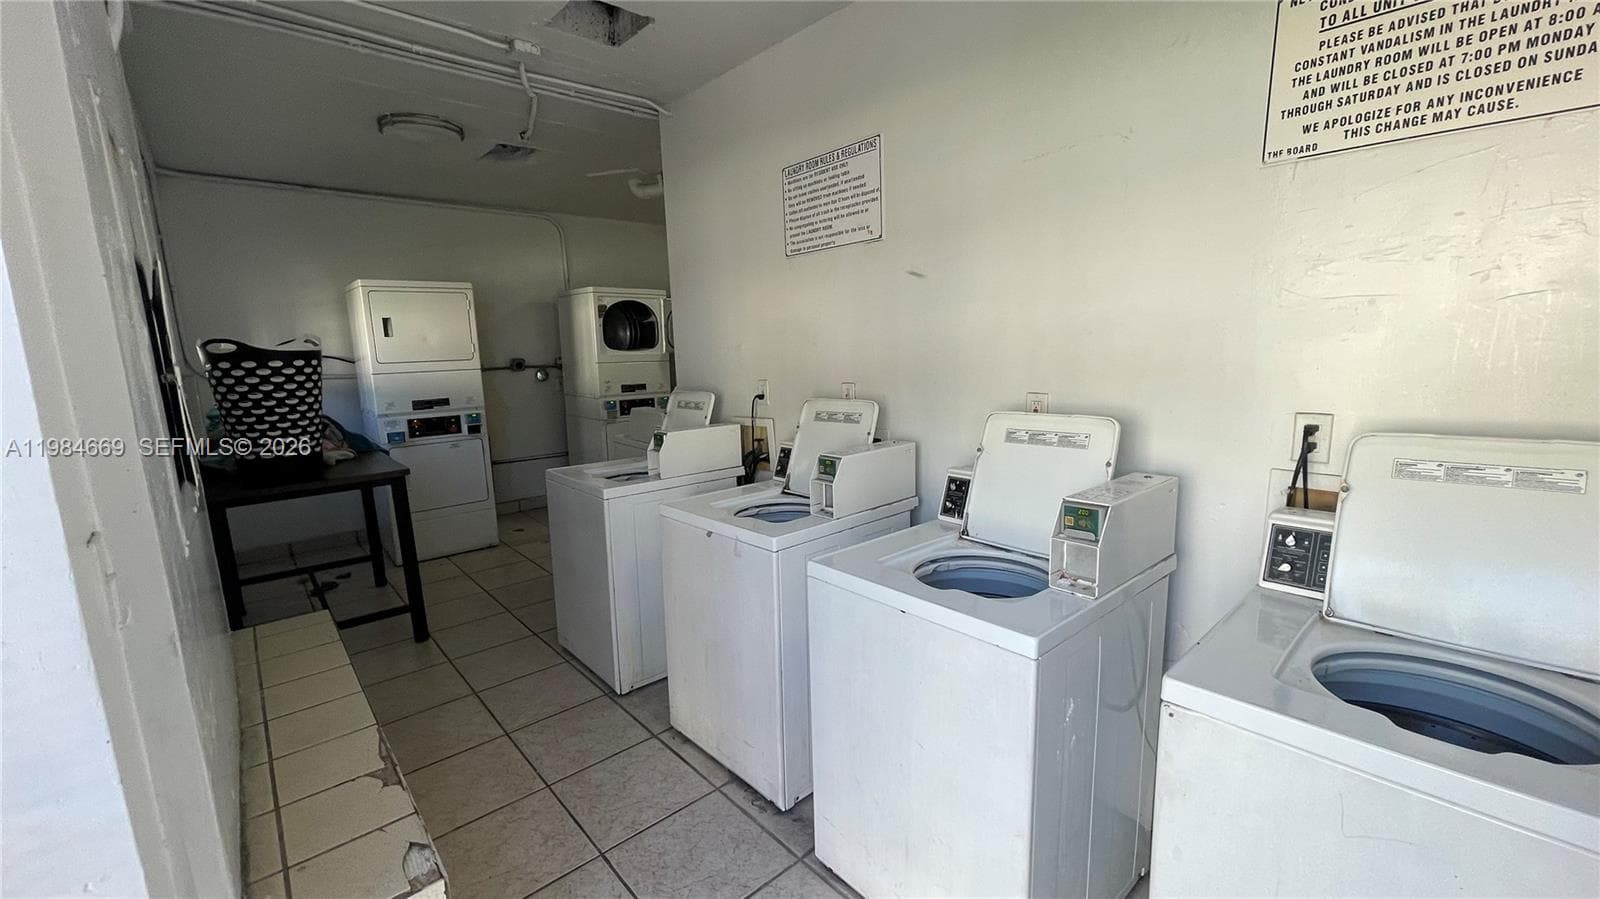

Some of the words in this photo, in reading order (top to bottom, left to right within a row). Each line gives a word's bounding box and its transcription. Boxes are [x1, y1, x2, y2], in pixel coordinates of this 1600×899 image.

[1319, 13, 1337, 30] TO
[1343, 4, 1368, 23] ALL
[1319, 29, 1364, 51] PLEASE
[1368, 24, 1384, 38] BE
[1389, 7, 1446, 32] ADVISED
[1292, 74, 1312, 88] THE
[1316, 59, 1371, 82] LAUNDRY
[1375, 49, 1412, 68] ROOM
[1418, 40, 1450, 58] WILL
[1456, 34, 1473, 49] BE
[1479, 23, 1518, 44] OPEN
[1524, 17, 1543, 33] AT
[1549, 6, 1586, 27] 8:00
[1295, 47, 1355, 73] CONSTANT
[1361, 27, 1435, 56] VANDALISM
[1440, 22, 1453, 36] IN
[1459, 14, 1485, 31] THE
[1303, 86, 1325, 100] AND
[1330, 78, 1359, 94] WILL
[1363, 73, 1378, 87] BE
[1383, 60, 1434, 82] CLOSED
[1439, 55, 1455, 70] AT
[1461, 47, 1492, 65] 7:00
[1498, 40, 1520, 56] PM
[1527, 22, 1595, 50] MONDAY
[1281, 99, 1333, 120] THROUGH
[1337, 84, 1400, 108] SATURDAY
[1406, 77, 1432, 93] AND
[1438, 73, 1450, 86] IS
[1456, 60, 1511, 82] CLOSED
[1518, 54, 1538, 69] ON
[1302, 122, 1319, 135] WE
[1324, 107, 1391, 130] APOLOGIZE
[1396, 101, 1421, 116] FOR
[1427, 94, 1454, 110] ANY
[1460, 68, 1583, 104] INCONVENIENCE
[1343, 125, 1371, 140] THIS
[1376, 114, 1427, 134] CHANGE
[1432, 108, 1462, 124] MAY
[1467, 97, 1519, 117] CAUSE.
[785, 164, 804, 177] LAUNDRY
[806, 159, 818, 170] ROOM
[820, 153, 835, 166] RULES
[837, 152, 840, 160] &
[841, 139, 877, 159] REGULATIONS
[1287, 143, 1318, 155] BOARD
